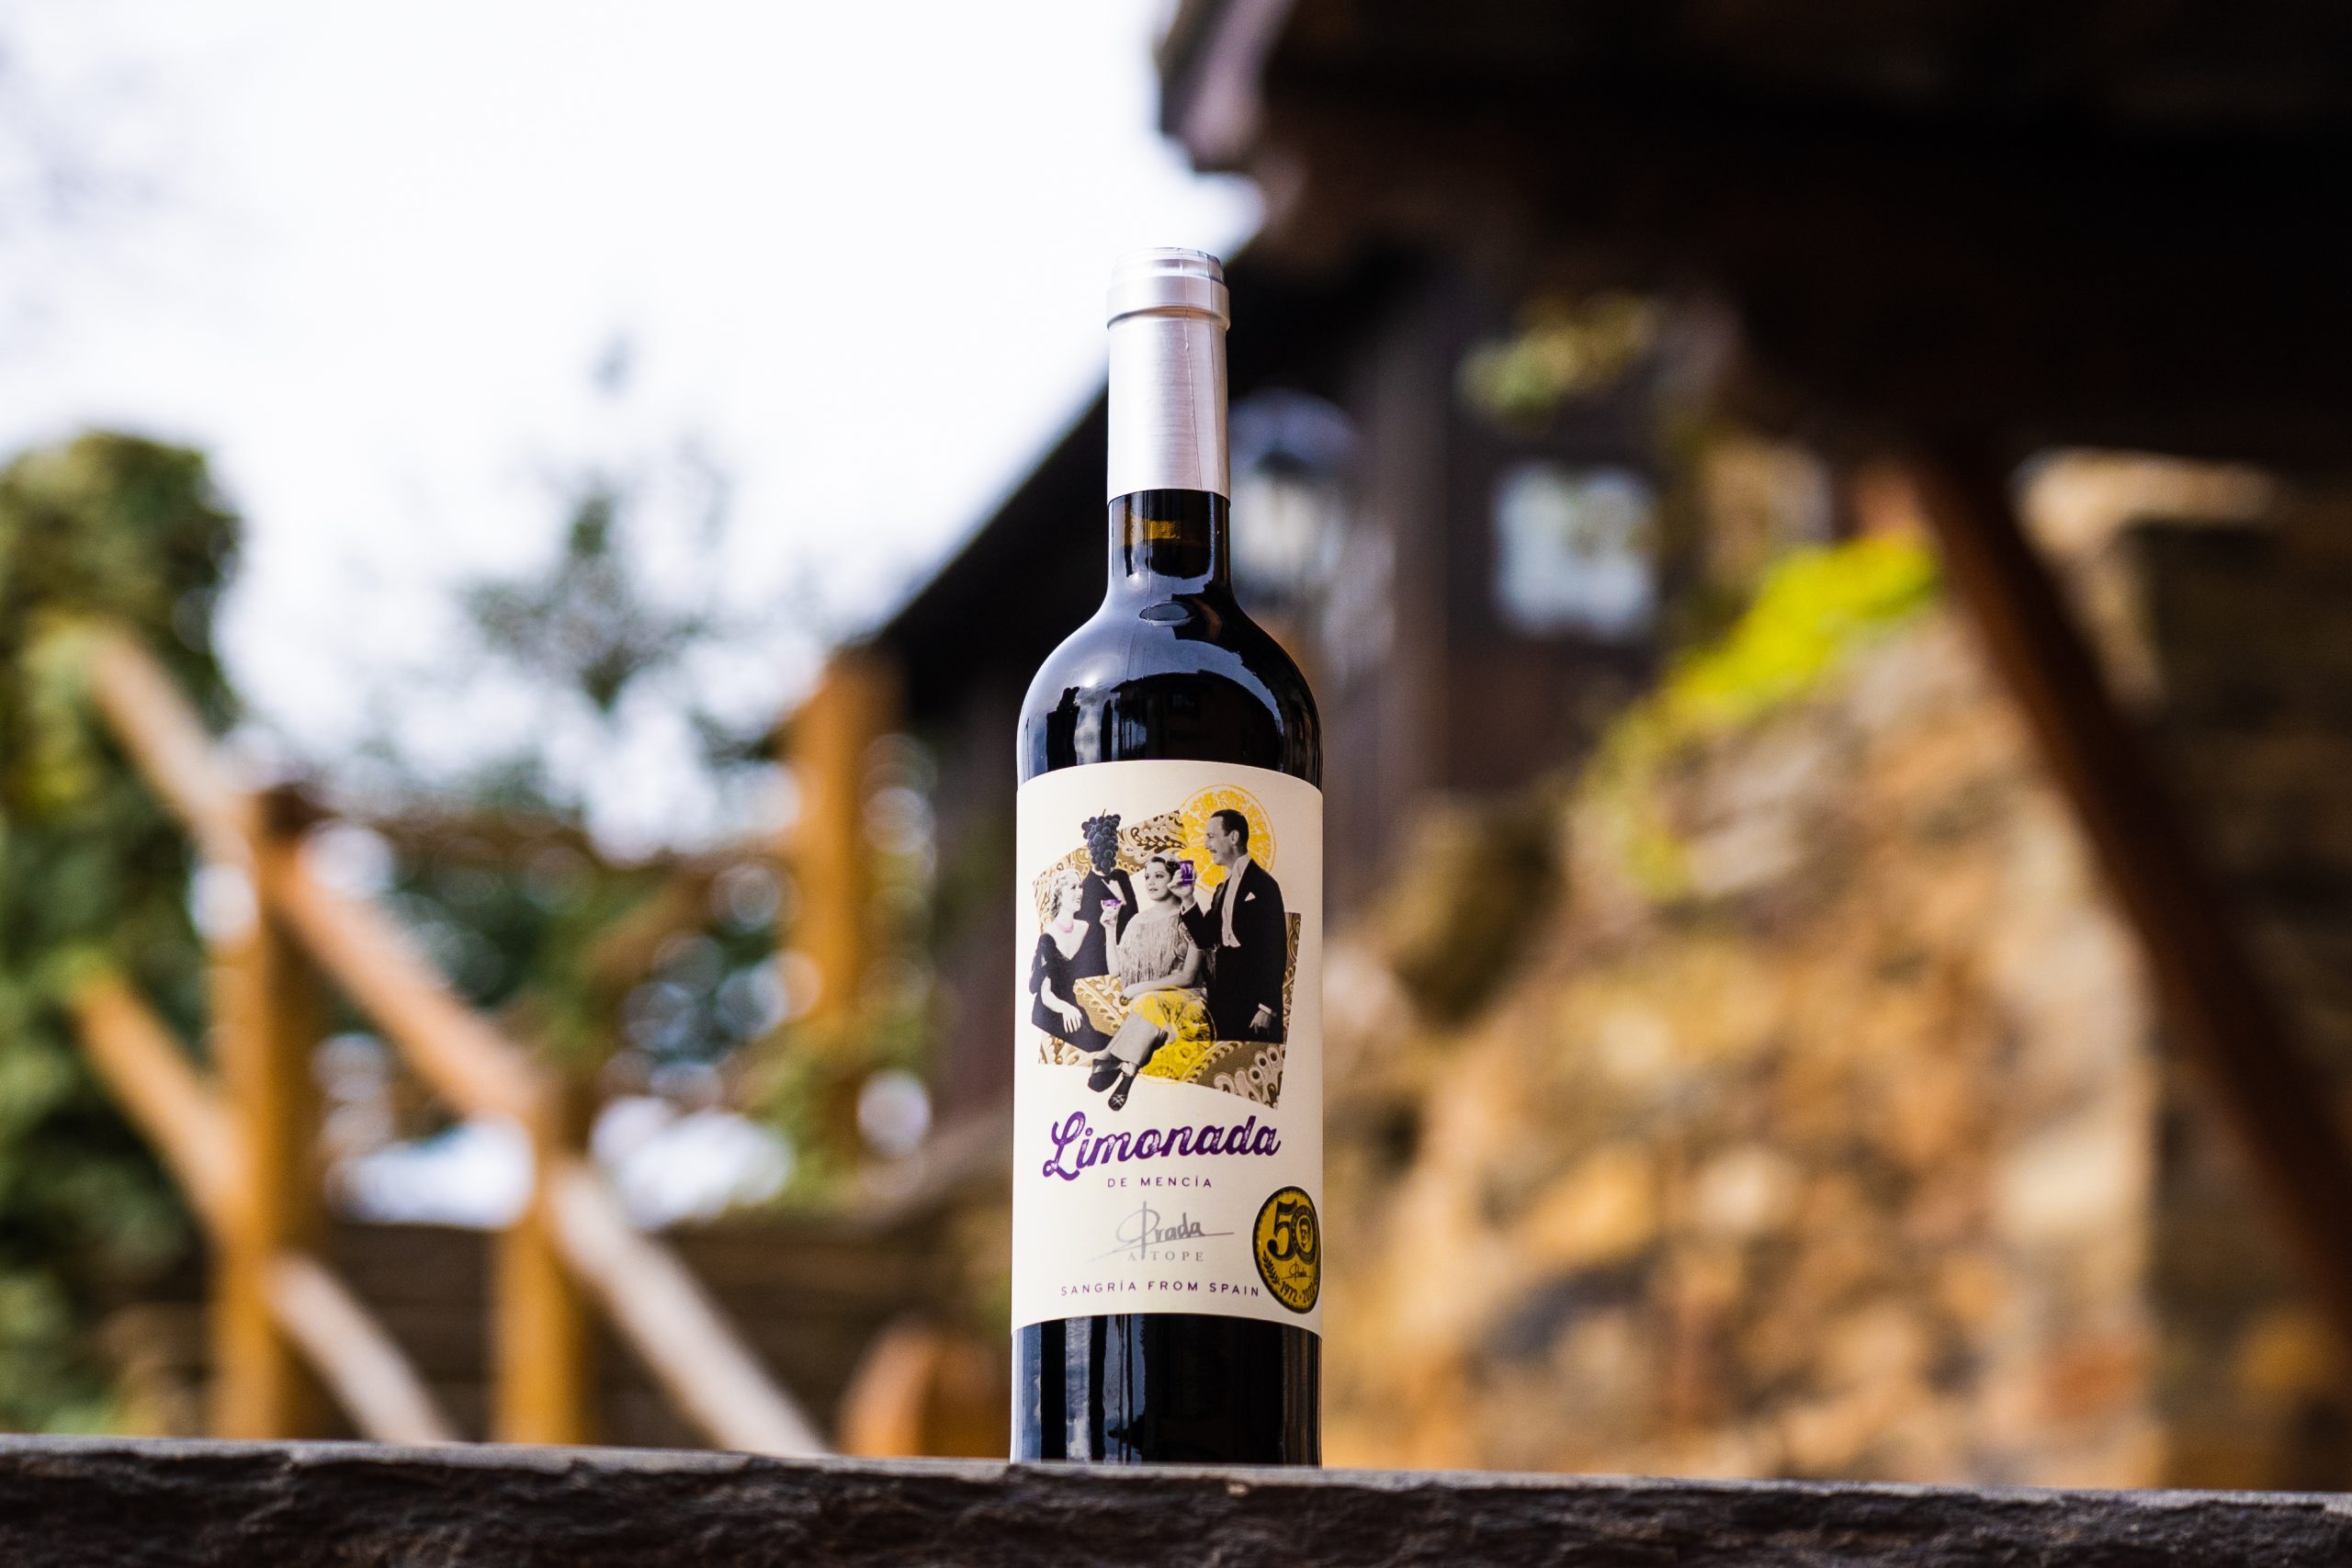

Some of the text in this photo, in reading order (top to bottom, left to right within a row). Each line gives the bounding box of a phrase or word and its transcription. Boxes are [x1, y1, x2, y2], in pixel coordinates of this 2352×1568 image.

[1043, 1111, 1281, 1181] Limonada
[1107, 1175, 1212, 1188] DE MENCÍA
[1109, 1201, 1224, 1260] Prada
[1151, 1250, 1204, 1262] TOPE
[1060, 1280, 1260, 1297] SANGRÍA FROM SPAIN
